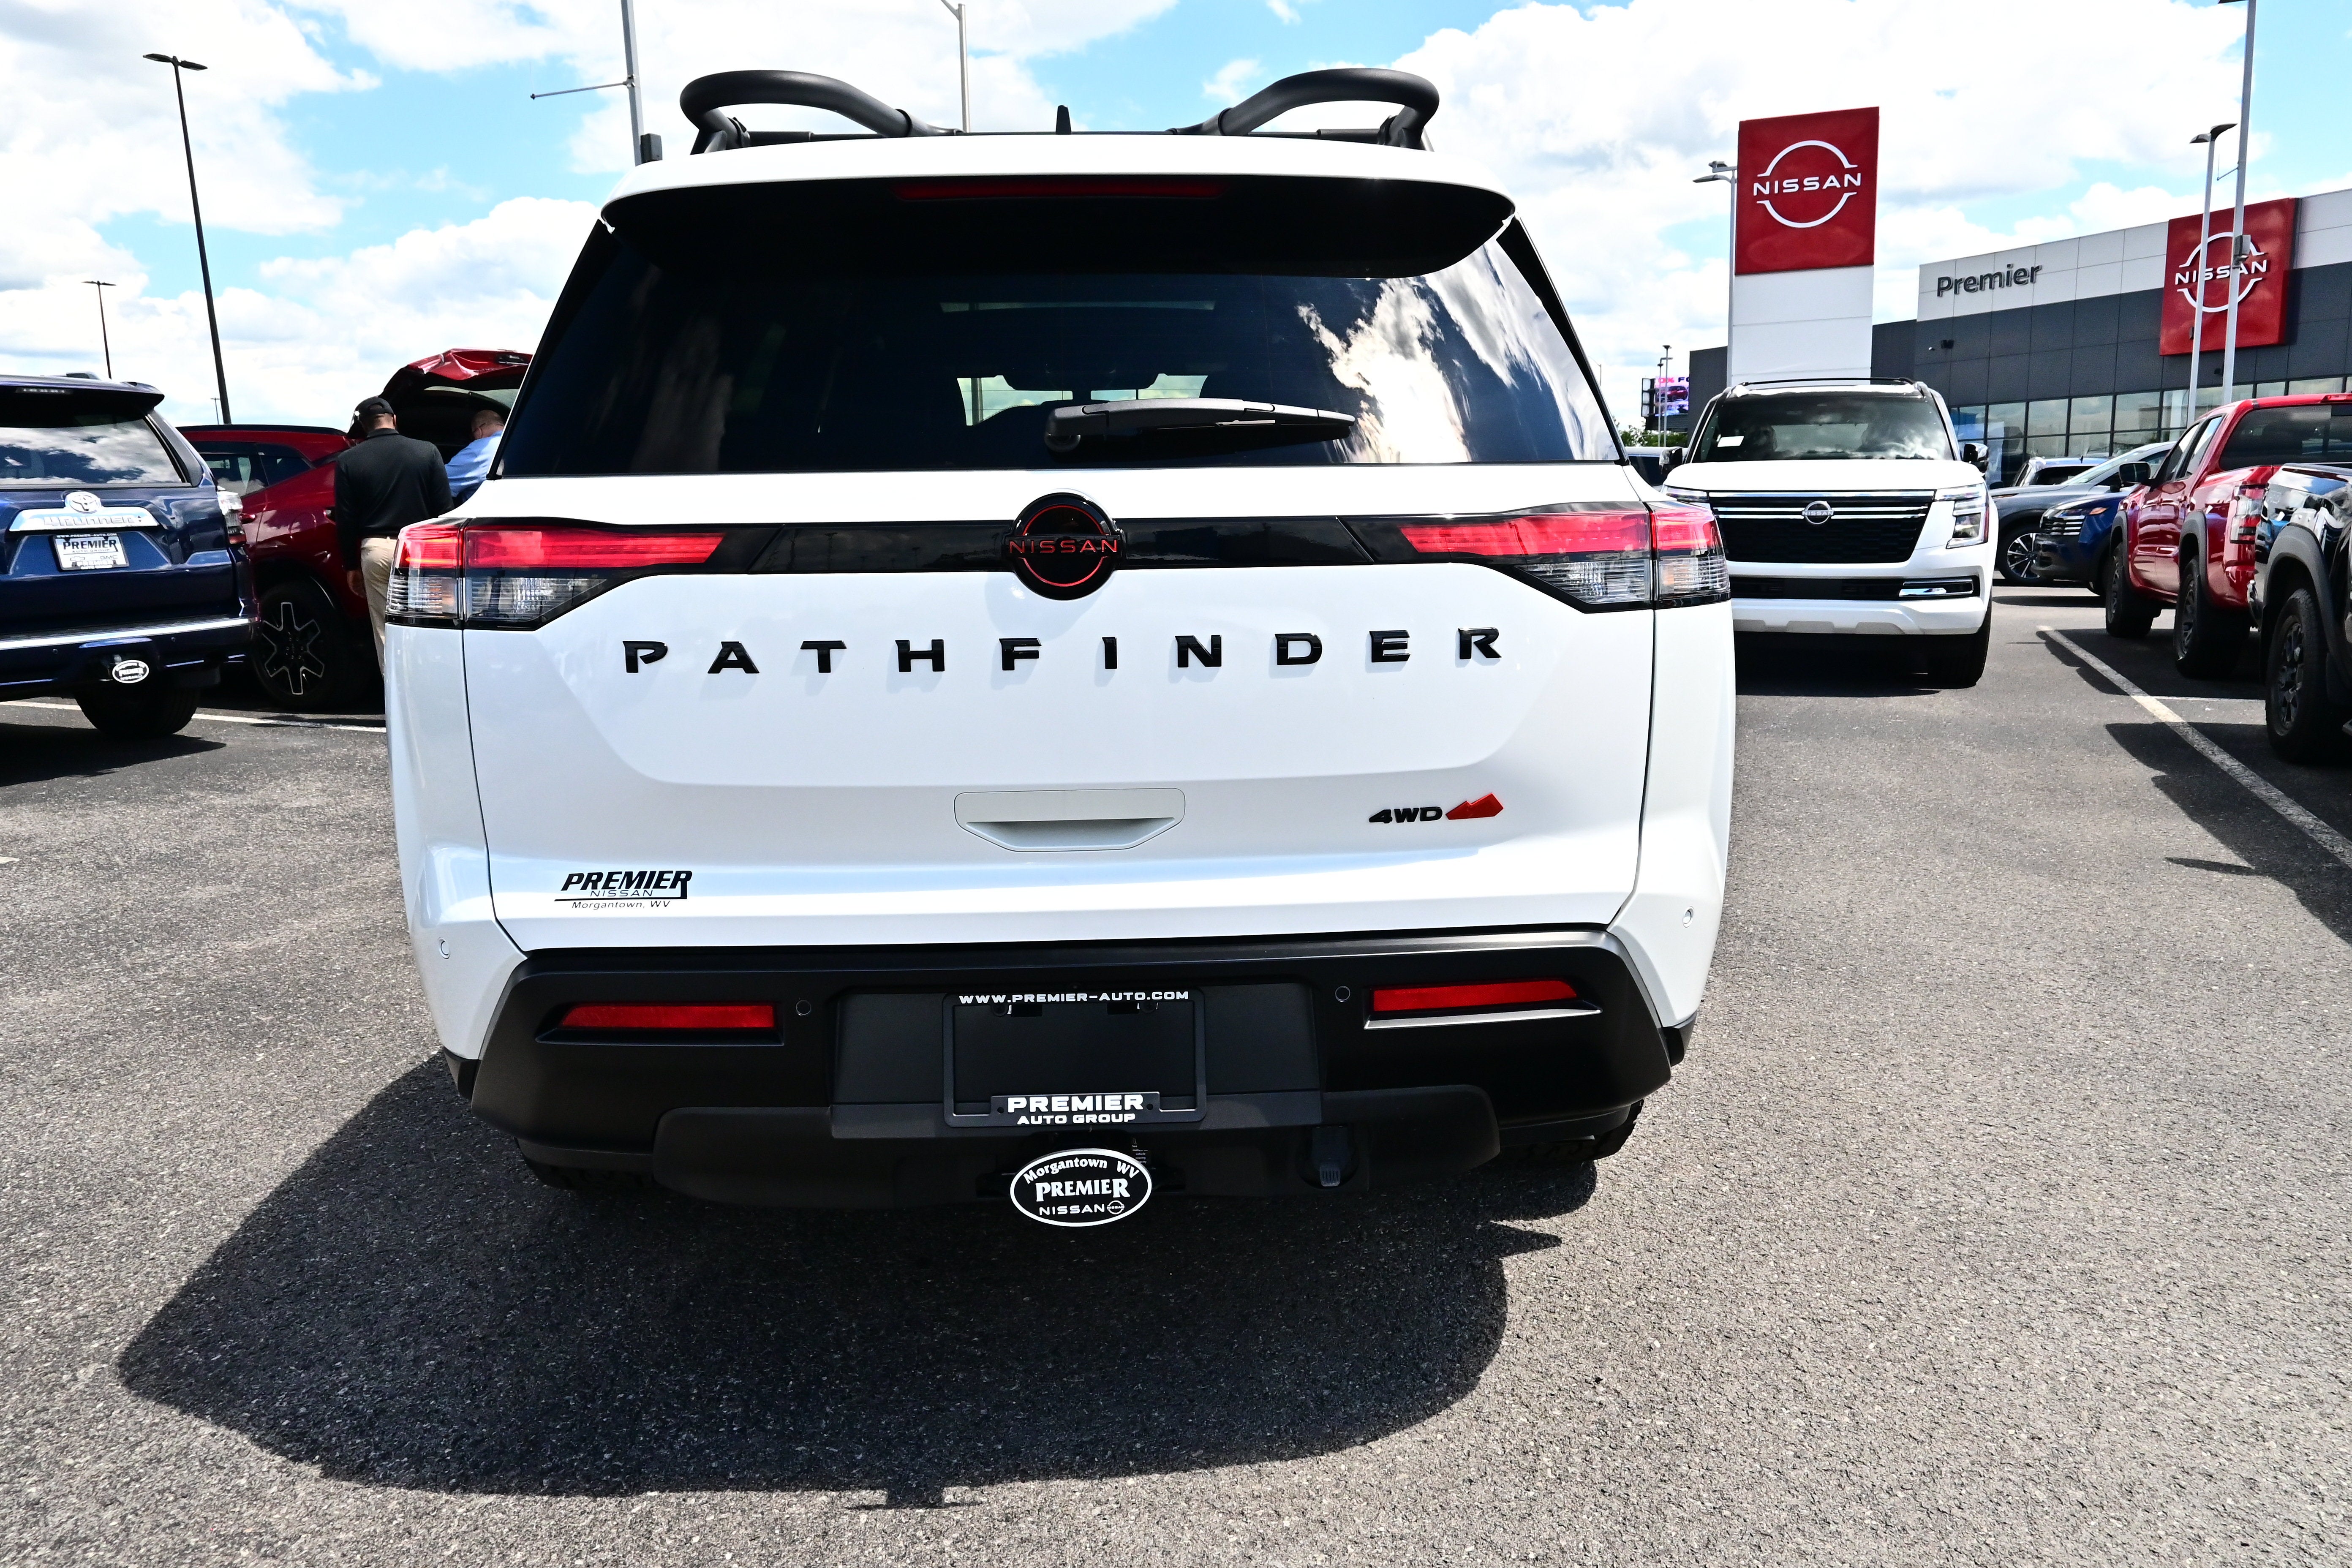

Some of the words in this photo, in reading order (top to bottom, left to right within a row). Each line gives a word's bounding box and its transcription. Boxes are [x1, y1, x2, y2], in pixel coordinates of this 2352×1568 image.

[1753, 173, 1861, 196] NISSAN
[1937, 264, 2042, 297] Premier
[2175, 259, 2267, 285] NISSAN
[63, 539, 118, 552] PREMIER
[1009, 539, 1117, 553] NISSAN
[622, 627, 1502, 674] PATHFINDER
[1369, 806, 1443, 824] 4WD
[561, 871, 692, 899] PREMIER
[572, 901, 645, 910] Morgantown,
[959, 991, 1189, 1004] WWW.PREMIER-AUTO.COM
[1008, 1094, 1143, 1113] PREMIER
[1017, 1115, 1067, 1125] AUTO
[1073, 1113, 1136, 1124] GROUP
[1023, 1157, 1108, 1184] Morgantown
[1117, 1161, 1140, 1178] WV
[1035, 1178, 1130, 1202] PREMIER
[1039, 1204, 1105, 1215] NISSAN
